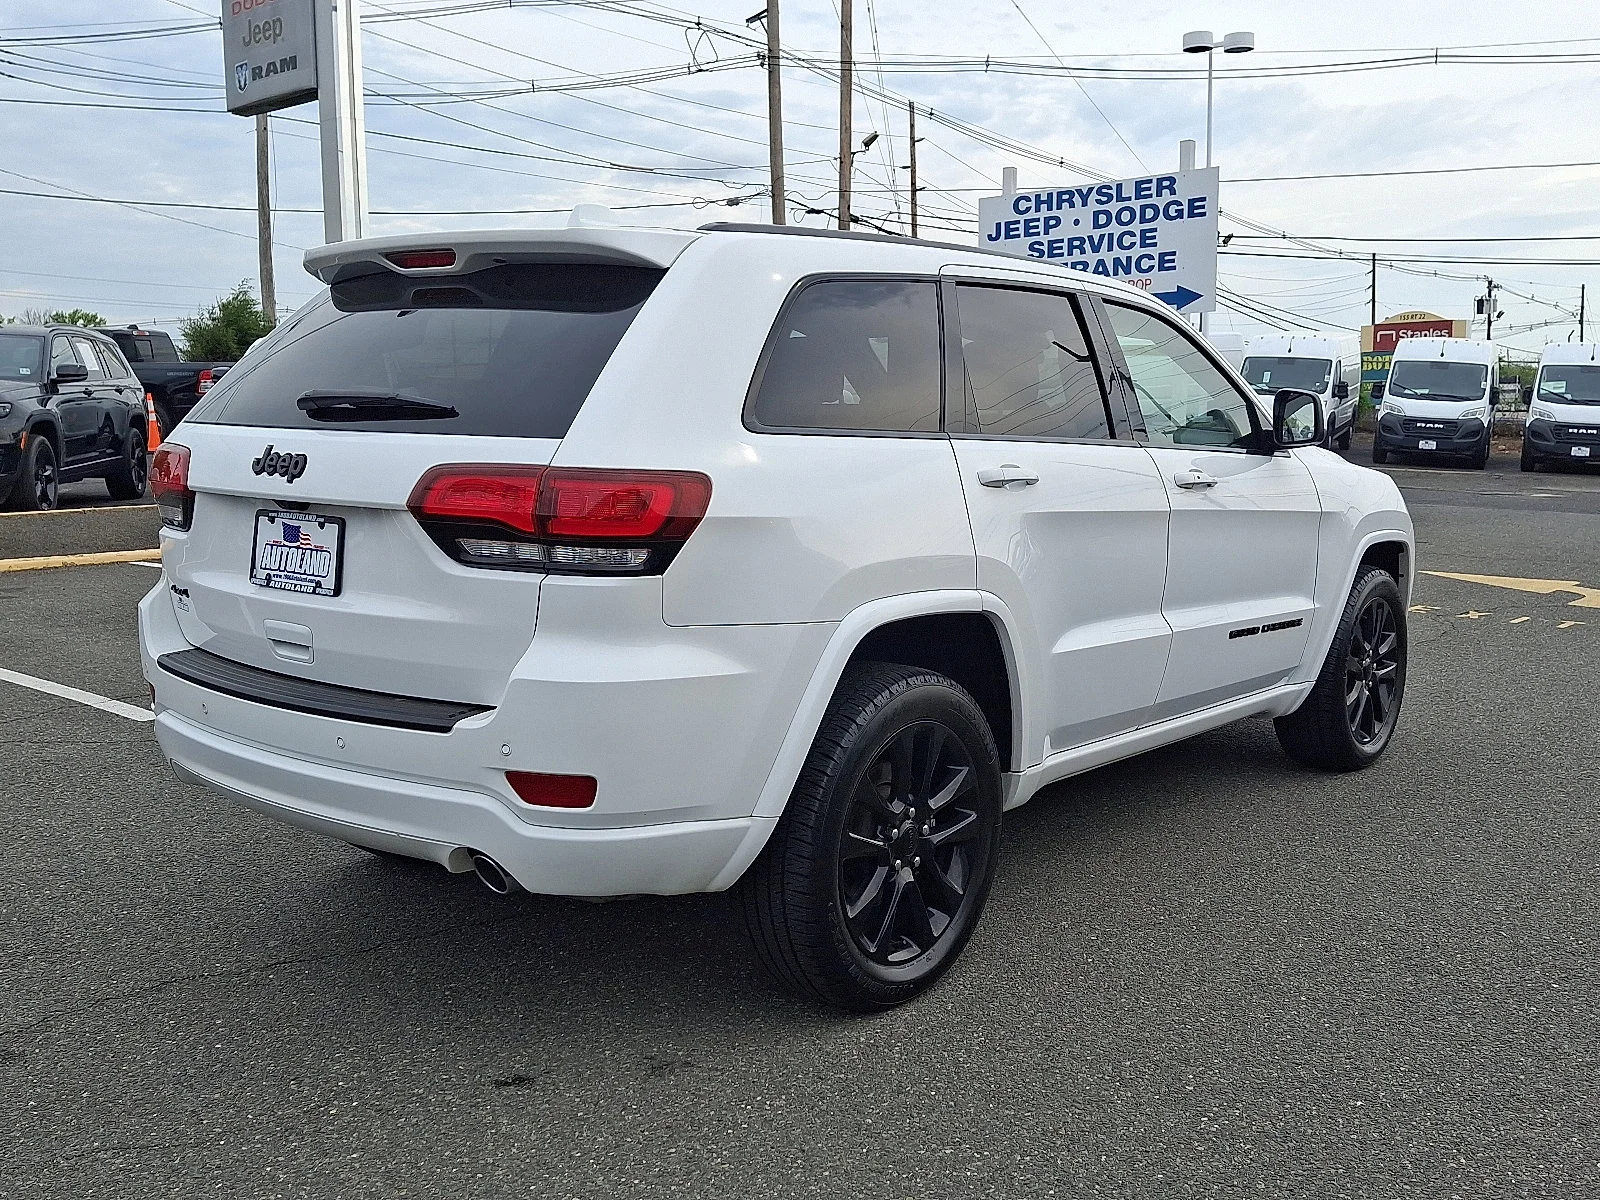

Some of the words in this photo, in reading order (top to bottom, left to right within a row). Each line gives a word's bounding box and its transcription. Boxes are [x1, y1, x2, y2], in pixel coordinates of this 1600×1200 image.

[242, 16, 283, 47] Jeep
[251, 55, 298, 81] RAM
[1012, 175, 1177, 215] CHRYSLER
[987, 215, 1062, 242] JEEP
[1092, 196, 1207, 230] DODGE
[1027, 228, 1158, 259] SERVICE
[1062, 251, 1177, 277] RANCE
[1399, 328, 1449, 340] Staples
[251, 444, 308, 484] Jeep
[261, 544, 331, 577] AUTOLAND
[269, 581, 314, 593] AUTOLAND
